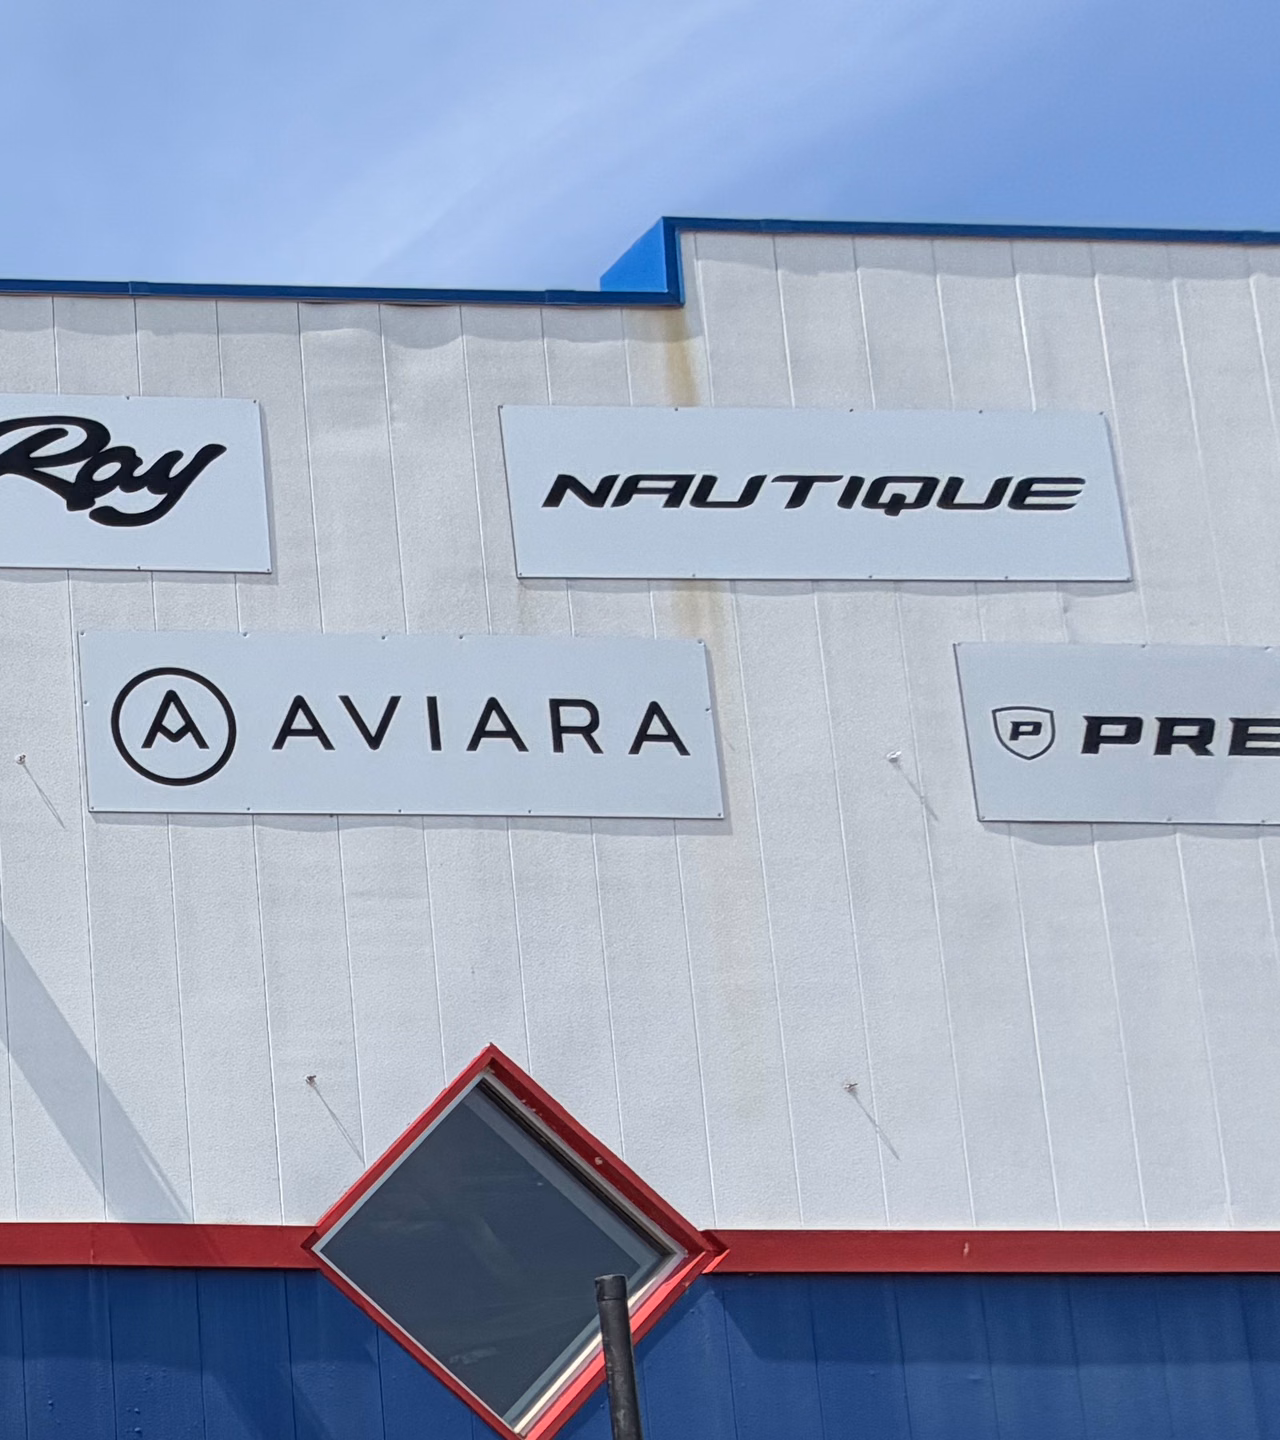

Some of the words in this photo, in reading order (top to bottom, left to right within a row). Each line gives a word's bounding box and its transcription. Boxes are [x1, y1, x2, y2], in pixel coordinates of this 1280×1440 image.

[541, 473, 1086, 517] NAUTIQUE
[271, 694, 691, 756] AVIARA
[1080, 715, 1280, 757] PRE
